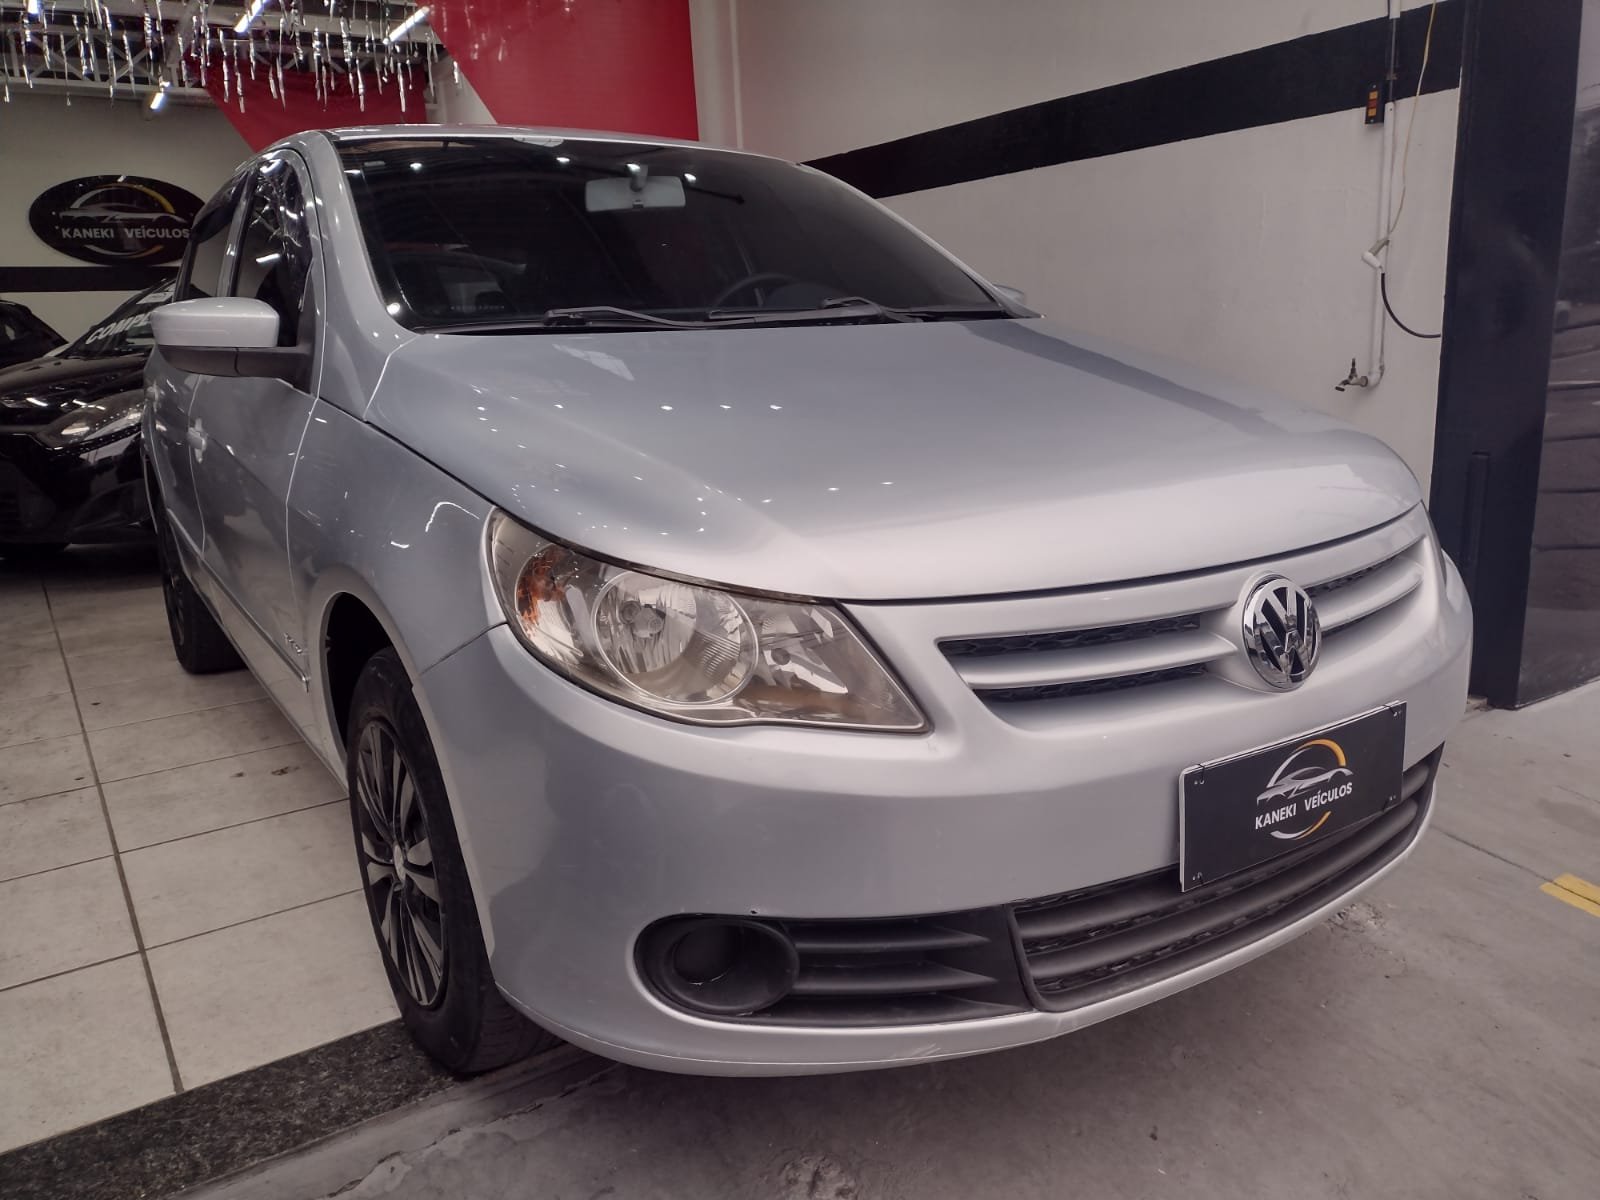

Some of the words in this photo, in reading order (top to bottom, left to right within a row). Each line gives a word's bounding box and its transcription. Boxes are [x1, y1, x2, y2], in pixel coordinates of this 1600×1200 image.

[62, 228, 114, 238] KANEKI
[124, 226, 190, 239] VEÍCULOS
[85, 312, 151, 344] COMPL
[1255, 803, 1297, 830] KANEKI
[1304, 782, 1353, 811] VEÍCULOS
